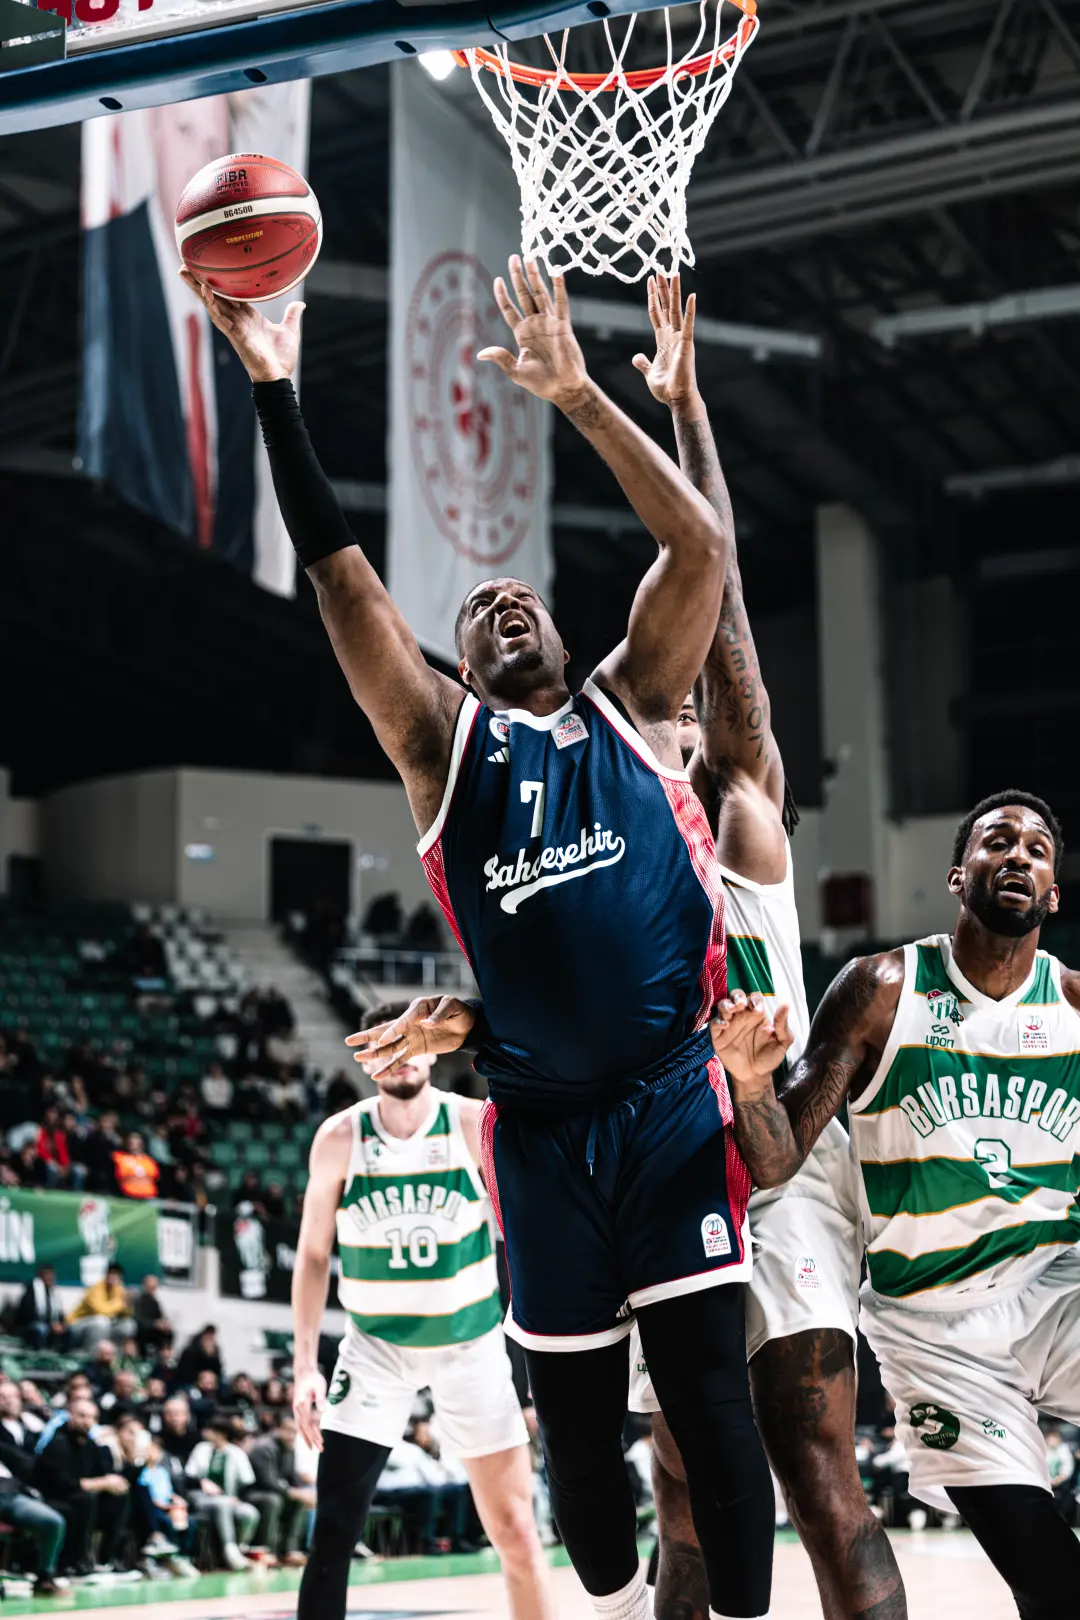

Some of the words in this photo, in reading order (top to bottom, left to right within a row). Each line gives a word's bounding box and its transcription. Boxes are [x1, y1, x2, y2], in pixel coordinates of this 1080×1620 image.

[216, 169, 248, 185] FIBA
[223, 205, 254, 219] BG4500
[519, 780, 545, 838] 7
[925, 1034, 955, 1049] upon
[900, 1072, 1080, 1143] BURSASPOR
[974, 1137, 1013, 1189] 2
[347, 1184, 466, 1233] BURSASPO
[384, 1226, 438, 1269] 10
